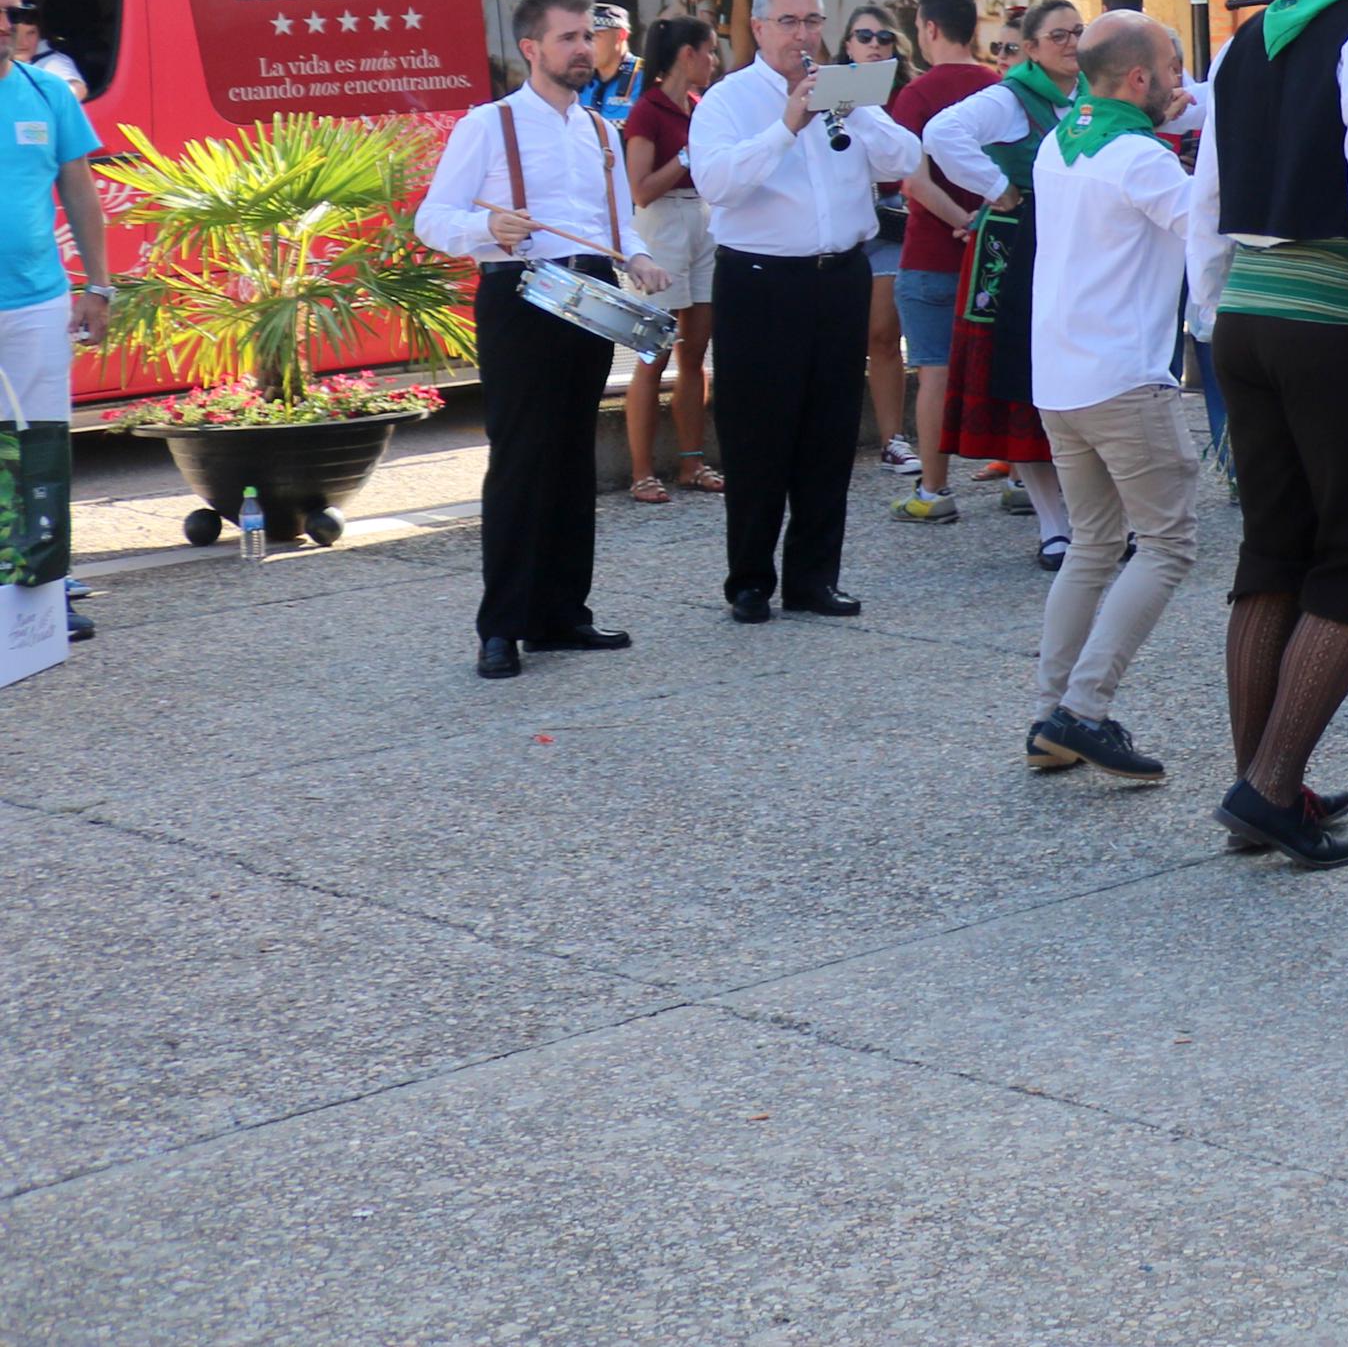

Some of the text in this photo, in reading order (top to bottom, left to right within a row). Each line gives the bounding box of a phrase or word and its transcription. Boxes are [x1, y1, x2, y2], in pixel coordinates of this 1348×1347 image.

[258, 48, 441, 78] La vida es más vida
[228, 74, 473, 102] cuando nos encontramos.
